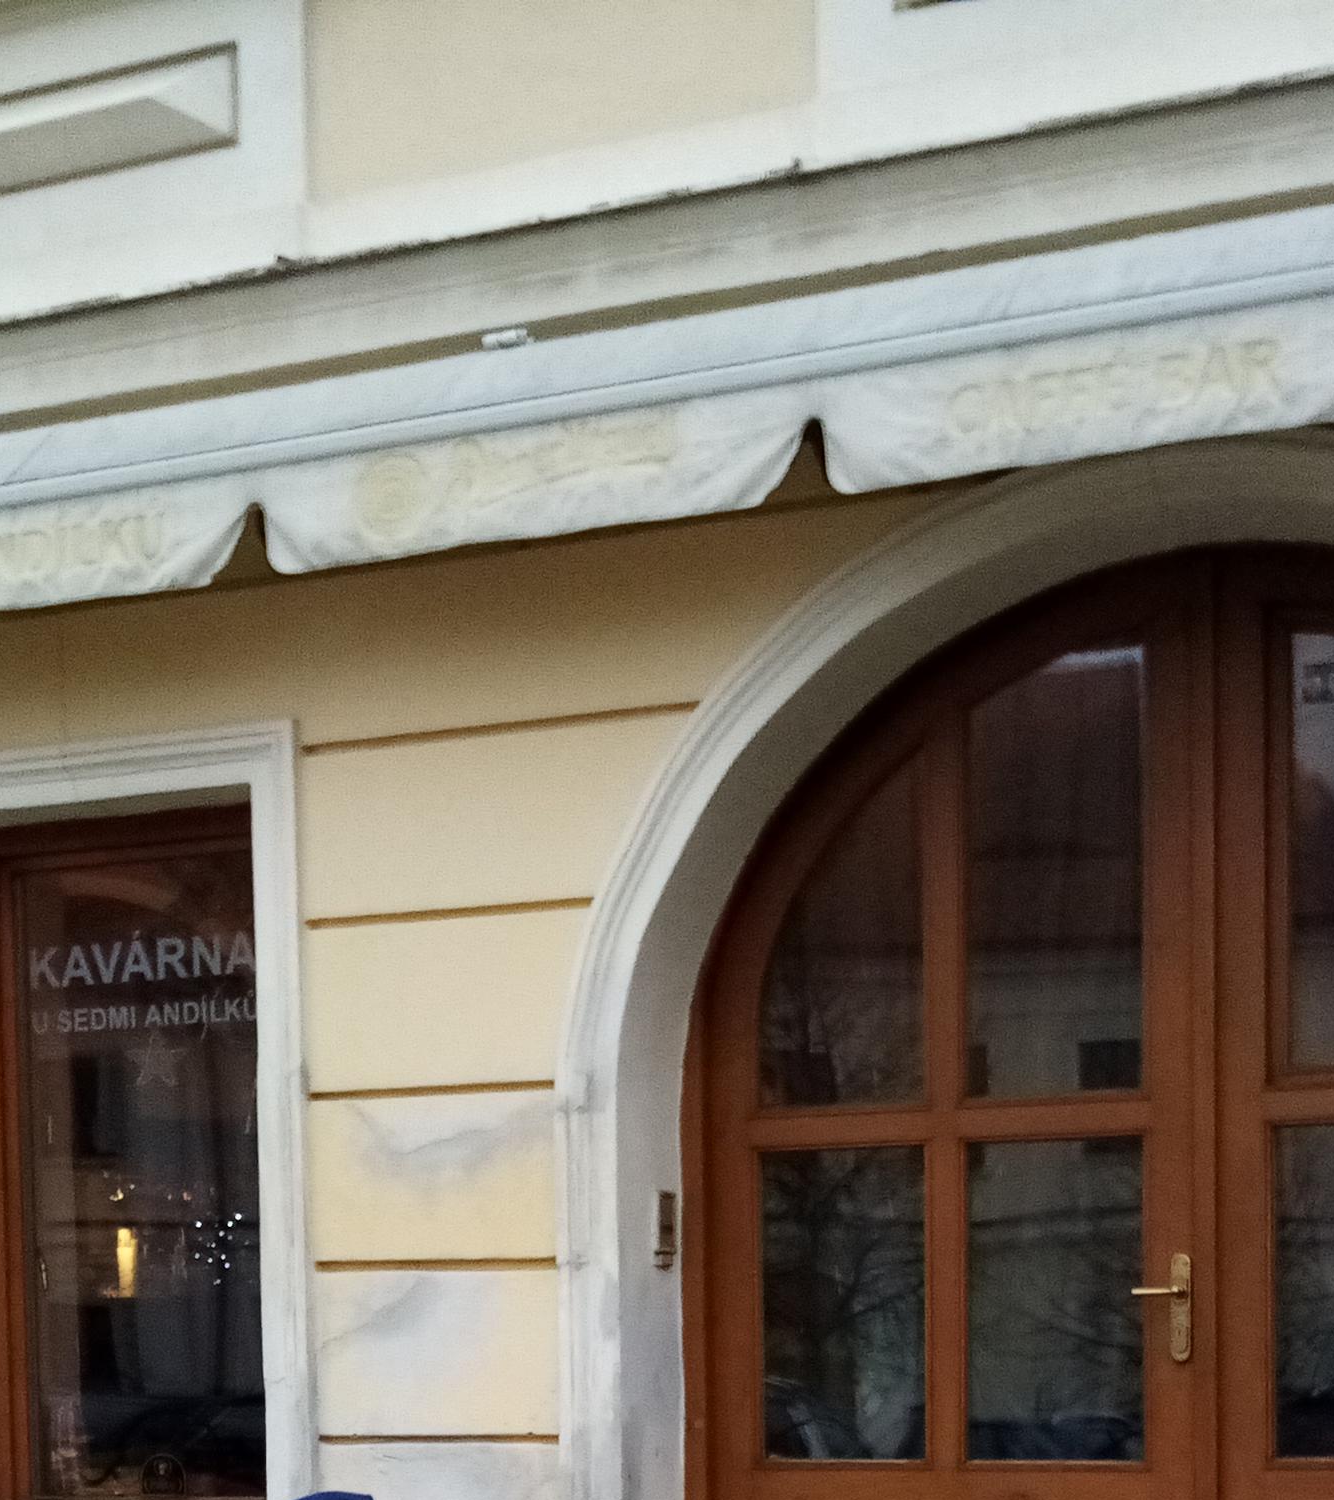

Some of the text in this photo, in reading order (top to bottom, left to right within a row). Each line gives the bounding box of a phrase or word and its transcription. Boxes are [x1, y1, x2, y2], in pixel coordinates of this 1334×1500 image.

[28, 929, 256, 991] KAVÁRNA
[31, 1011, 49, 1035] U
[57, 1005, 137, 1034] SEDMI
